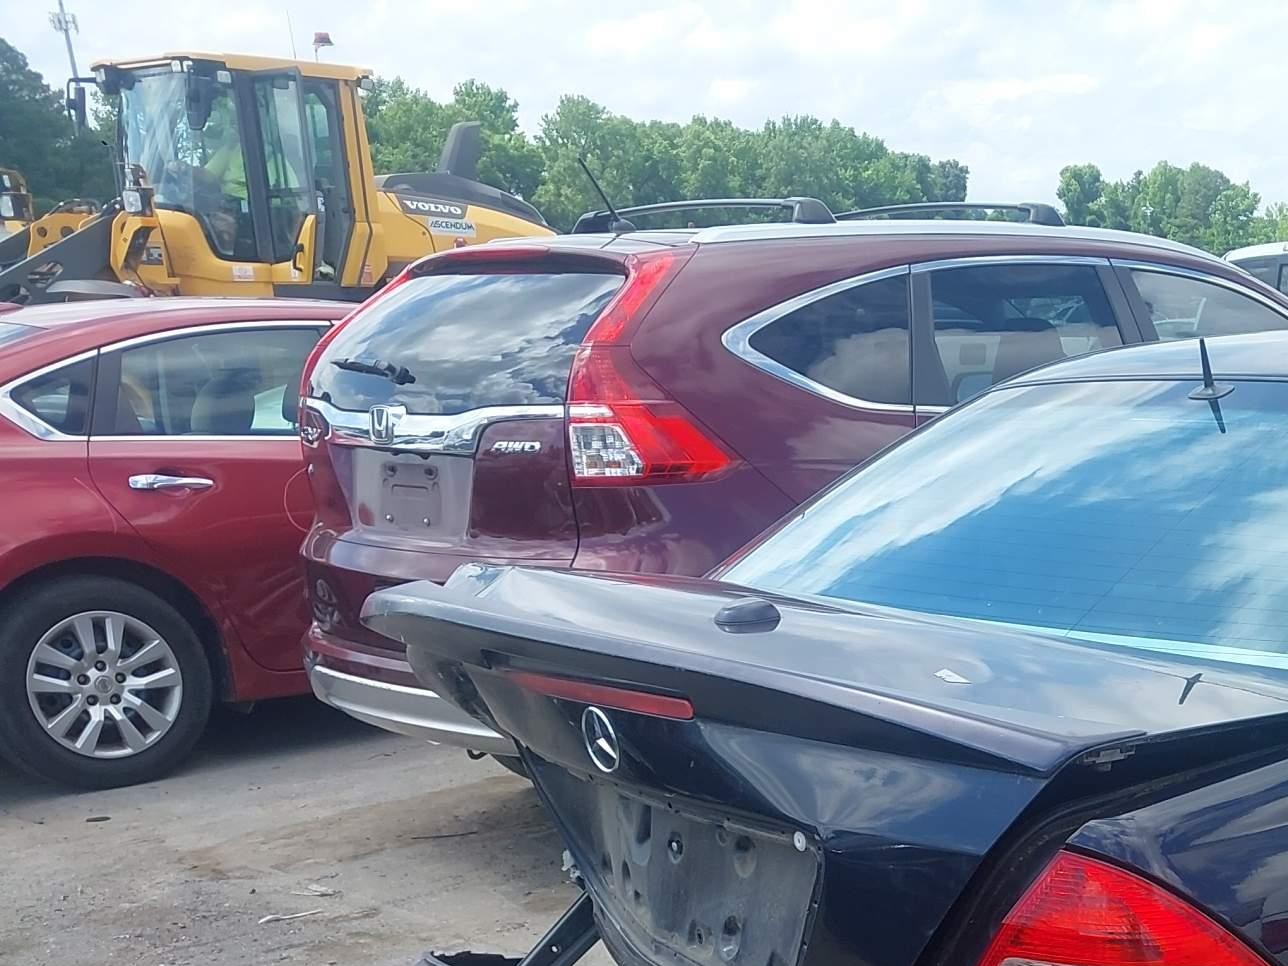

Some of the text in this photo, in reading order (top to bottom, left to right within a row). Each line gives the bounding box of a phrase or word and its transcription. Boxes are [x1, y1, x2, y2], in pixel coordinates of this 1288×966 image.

[402, 200, 462, 214] VOLVO
[430, 220, 475, 231] ASCENDUM
[490, 441, 541, 453] AWD
